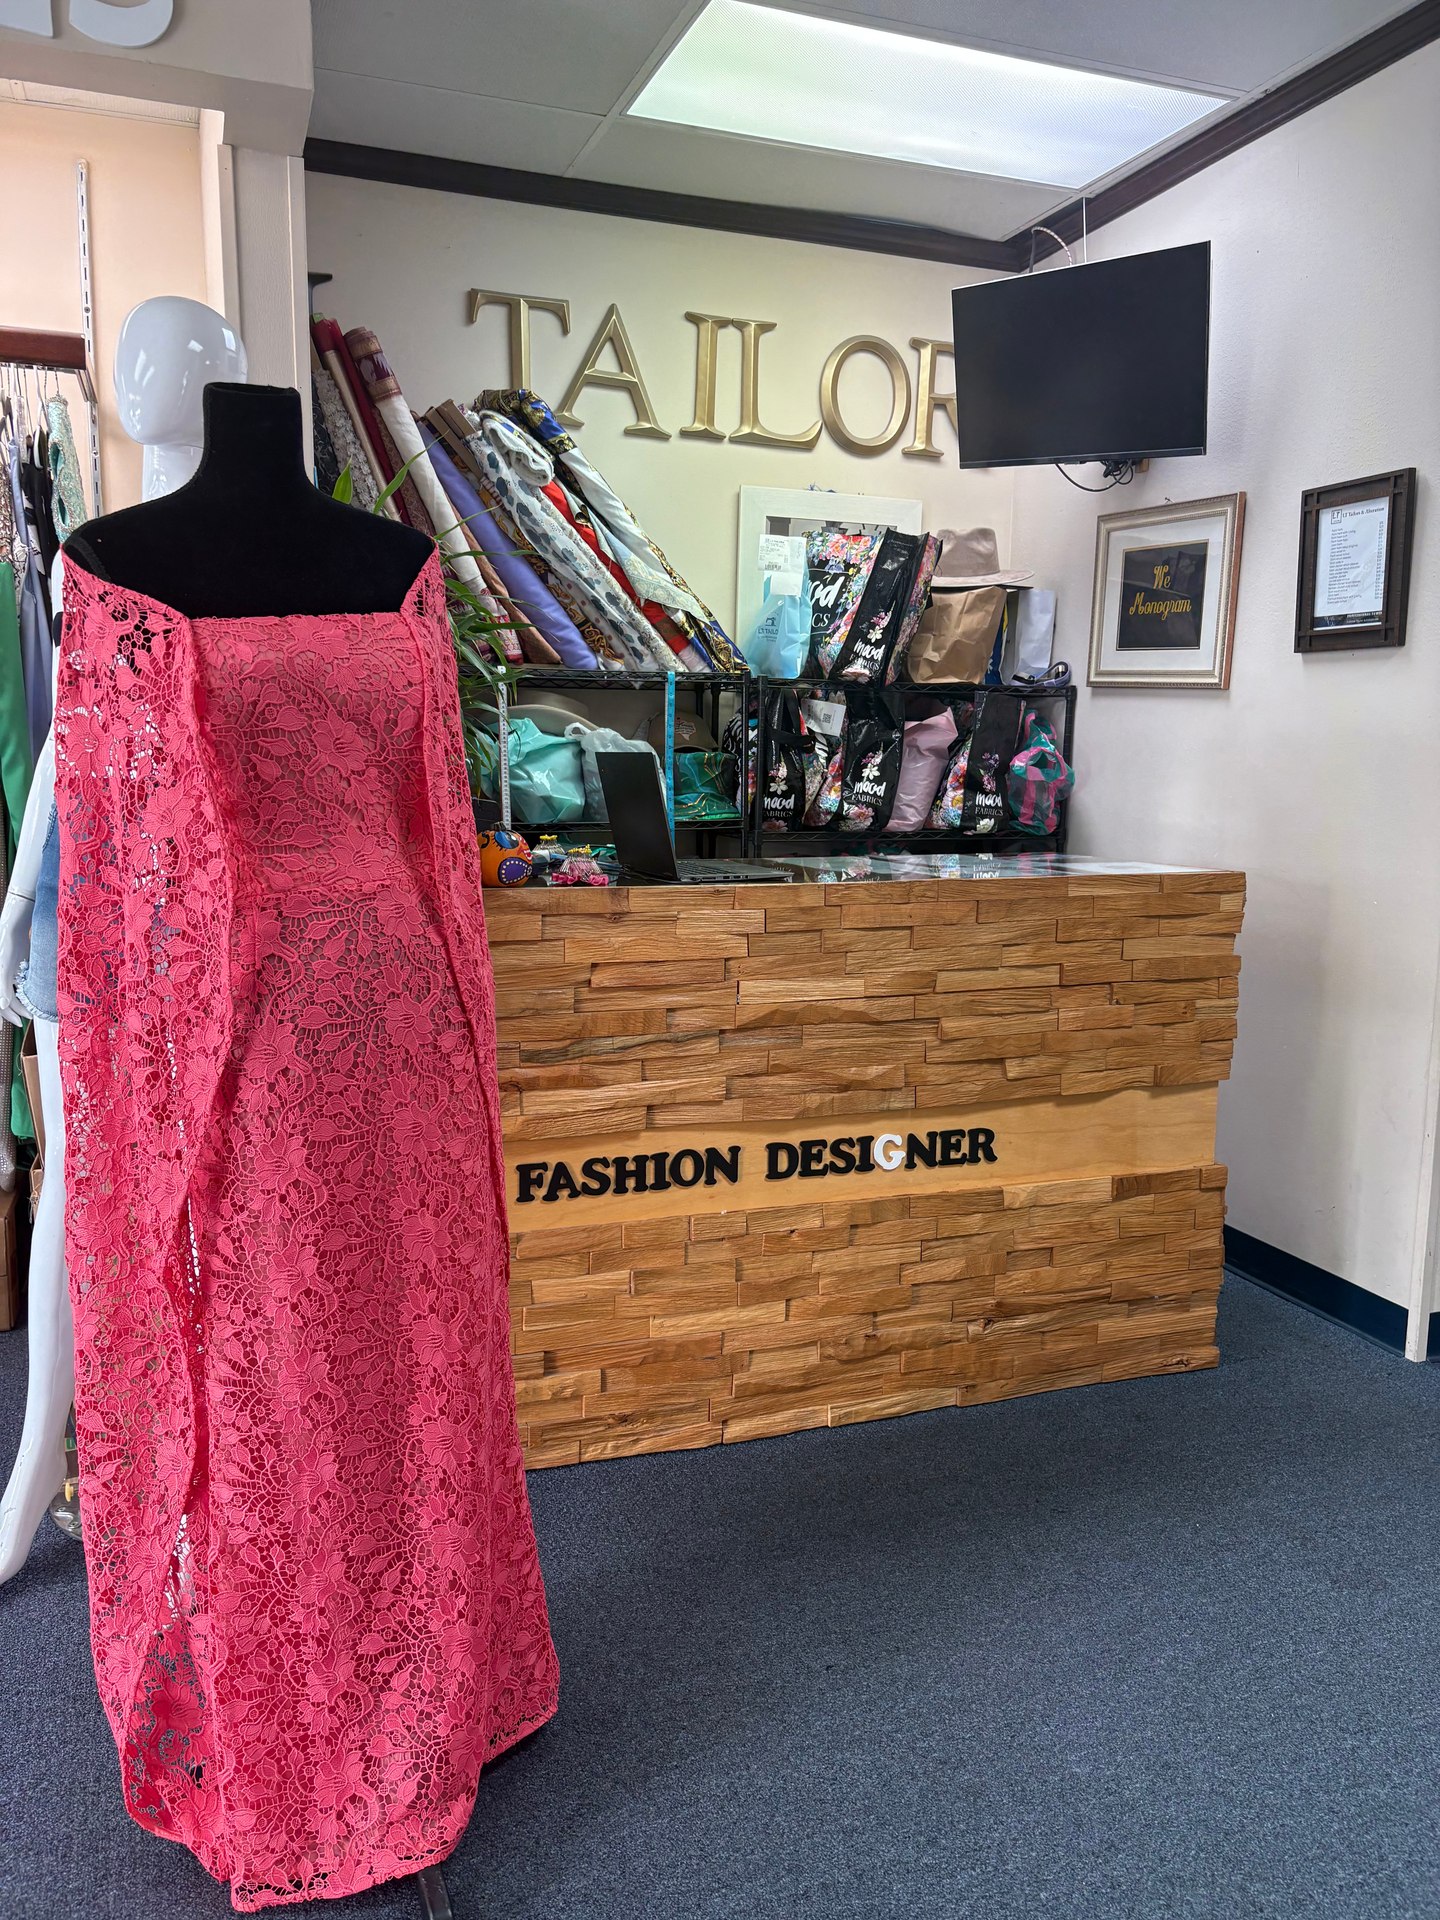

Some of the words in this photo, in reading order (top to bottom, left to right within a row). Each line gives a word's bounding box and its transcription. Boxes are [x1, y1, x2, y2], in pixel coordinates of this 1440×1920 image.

[469, 287, 958, 458] TAILOR
[1153, 564, 1172, 590] We
[1129, 591, 1192, 621] Monogram
[853, 638, 886, 662] mood
[853, 781, 887, 797] mood
[851, 793, 883, 807] FABRICS
[975, 791, 1003, 808] mood
[763, 810, 794, 818] ABRICS
[975, 806, 1003, 817] FABRICS
[515, 1144, 742, 1203] FASHION
[765, 1127, 998, 1181] DESIGNER
